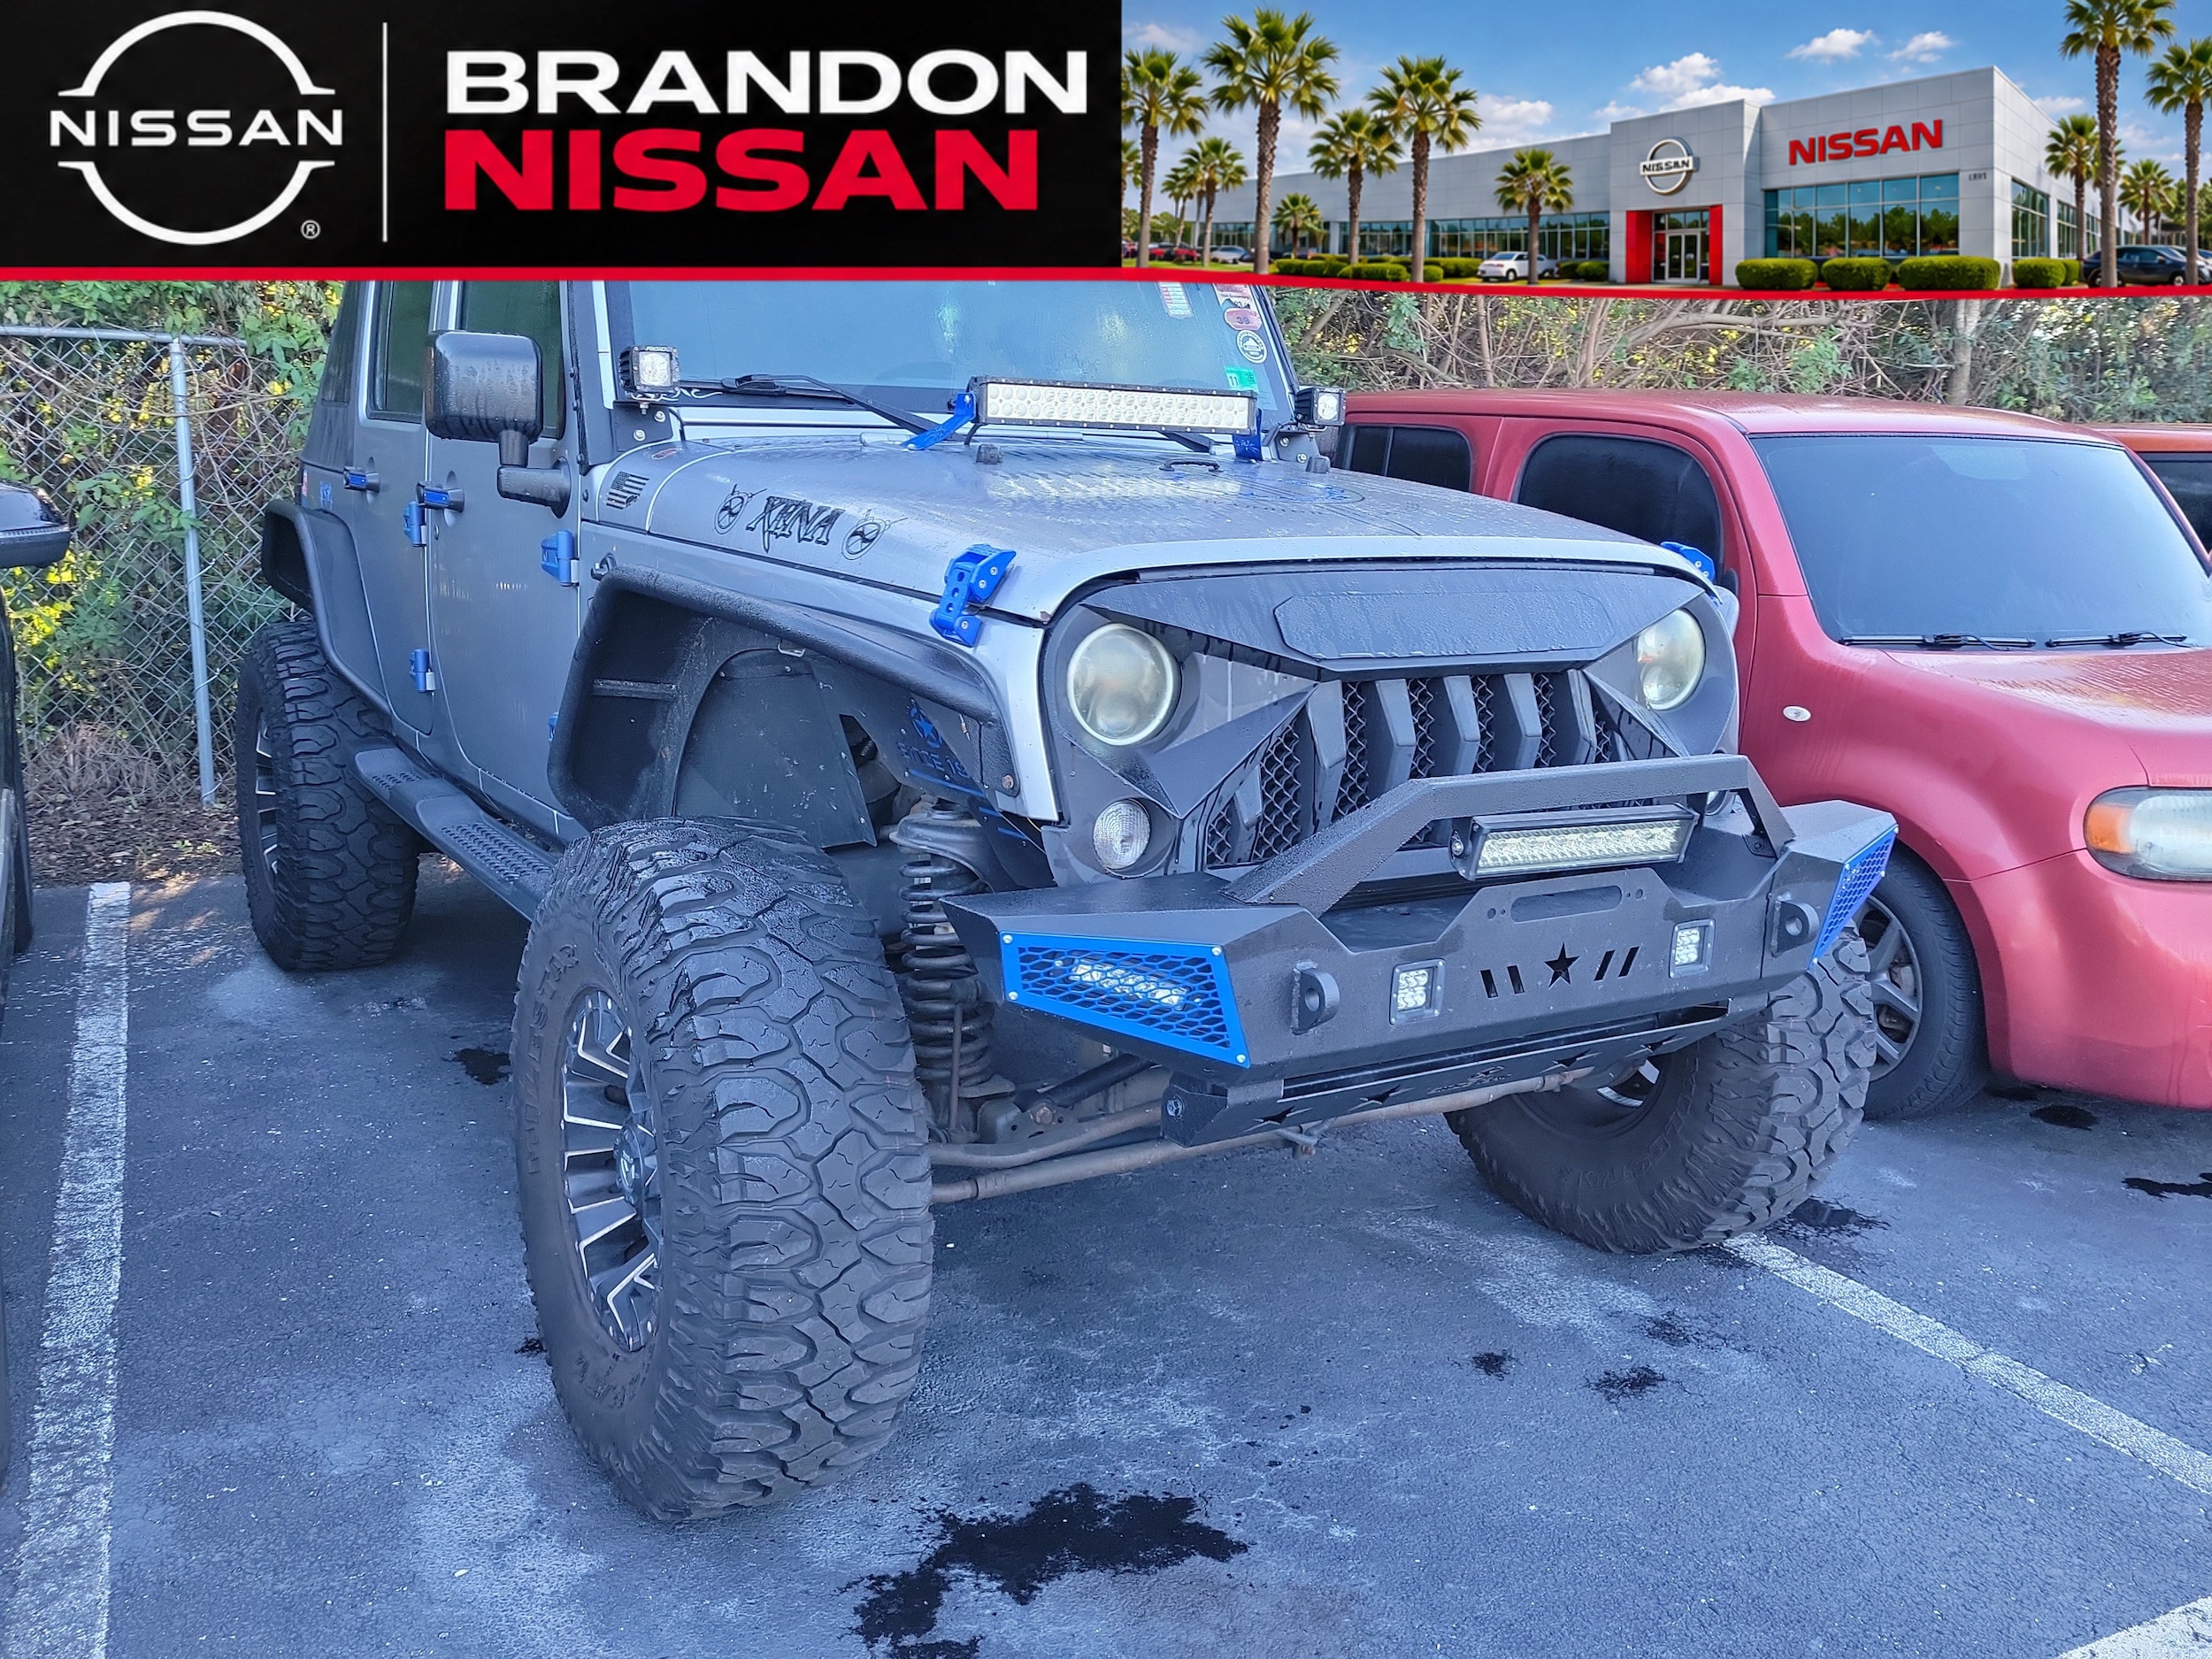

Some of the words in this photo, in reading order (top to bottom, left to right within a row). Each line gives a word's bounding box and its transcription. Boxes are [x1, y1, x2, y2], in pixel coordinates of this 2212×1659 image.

[1236, 316, 1250, 325] 39
[1229, 375, 1239, 387] 11
[745, 495, 846, 555] XENA
